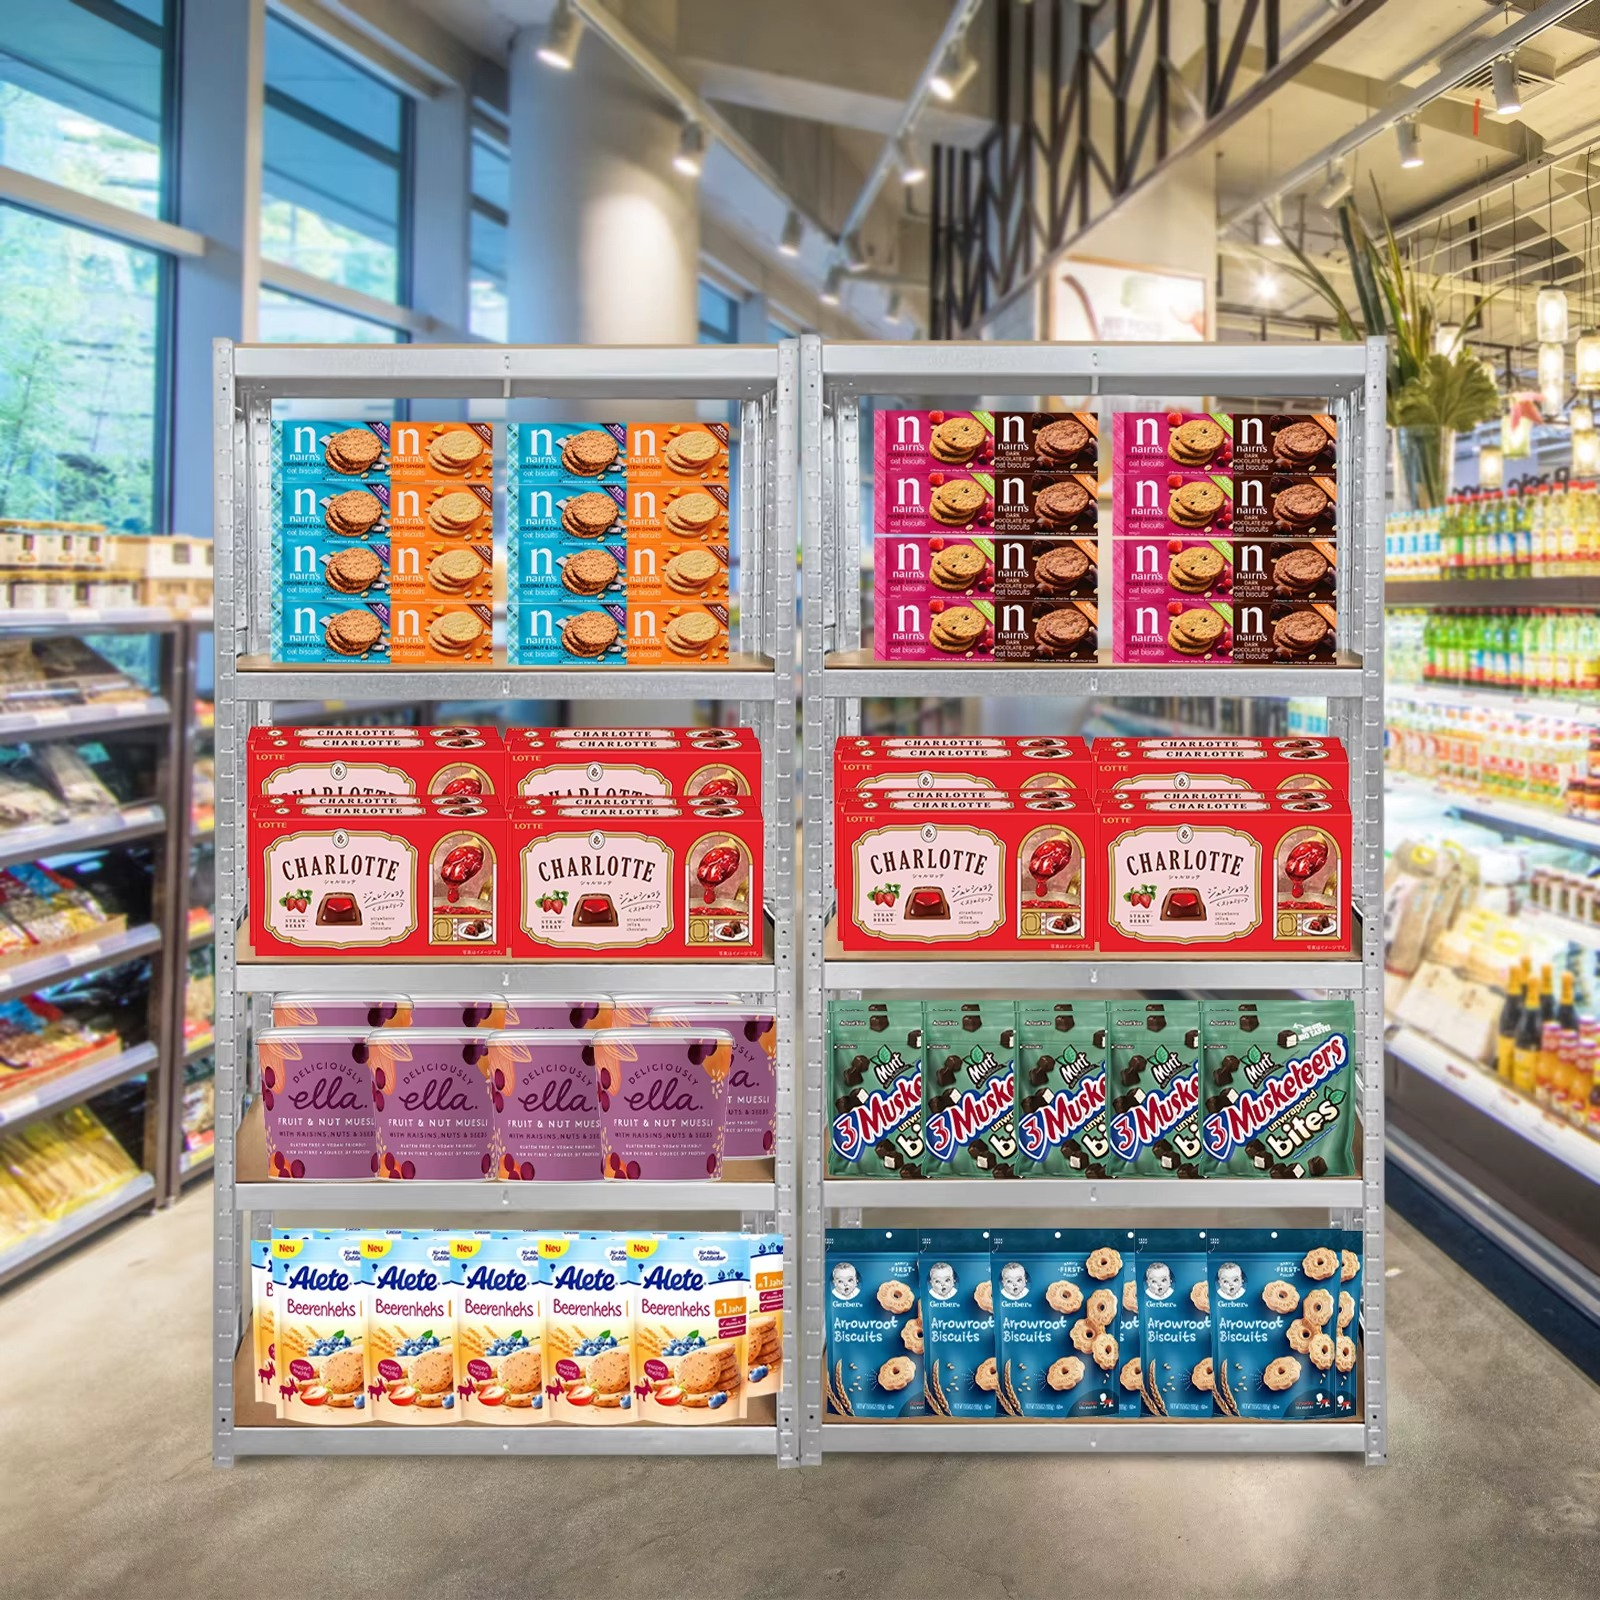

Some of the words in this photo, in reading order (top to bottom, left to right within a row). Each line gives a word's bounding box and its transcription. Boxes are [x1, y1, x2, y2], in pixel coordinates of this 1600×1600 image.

[898, 415, 920, 443] n
[1241, 418, 1263, 445] n
[294, 426, 316, 453] n
[634, 430, 656, 455] n
[893, 443, 925, 451] nairn's
[1131, 445, 1163, 453] nairn's
[1237, 445, 1267, 453] nairn's
[290, 453, 320, 461] nairn's
[629, 456, 660, 464] nairn's
[998, 504, 1029, 512] nairn's
[1131, 507, 1163, 515] nairn's
[290, 515, 320, 523] nairn's
[393, 517, 424, 525] nairn's
[526, 517, 556, 525] nairn's
[290, 634, 320, 642] nairn's
[393, 636, 424, 644] nairn's
[526, 636, 556, 644] nairn's
[629, 636, 660, 644] nairn's
[998, 631, 1029, 639] nairn's
[282, 855, 400, 881] CHARLOTTE
[870, 848, 988, 875] CHARLOTTE
[1127, 849, 1244, 876] CHARLOTTE
[538, 856, 656, 883] CHARLOTTE
[292, 1062, 363, 1085] DELICIOUSLY
[403, 1063, 473, 1085] DELICIOUSLY
[629, 1063, 698, 1085] DELICIOUSLY
[876, 1053, 903, 1081] Mint
[969, 1053, 996, 1081] Mint
[1062, 1053, 1089, 1081] Mint
[1153, 1053, 1181, 1082] Mint
[1246, 1053, 1273, 1082] Mint
[522, 1064, 592, 1086] DELICIOUSLY
[734, 1096, 770, 1104] MUESLI
[1207, 1118, 1226, 1150] 3
[1228, 1038, 1344, 1141] Musketeers
[838, 1117, 856, 1150] 3
[859, 1070, 921, 1140] Muske
[930, 1117, 949, 1150] 3
[952, 1070, 1014, 1140] Muske
[1023, 1117, 1042, 1150] 3
[1045, 1070, 1105, 1140] Muske
[1114, 1118, 1133, 1150] 3
[1135, 1074, 1198, 1141] Muske
[1268, 1090, 1318, 1131] unwrapped
[278, 1118, 302, 1126] FRUIT
[307, 1118, 313, 1126] &
[319, 1118, 340, 1126] NUT
[345, 1118, 375, 1126] MUESL
[389, 1119, 413, 1127] FRUIT
[418, 1119, 424, 1127] &
[429, 1119, 450, 1127] NUT
[456, 1119, 487, 1127] MUESLI
[508, 1120, 532, 1128] FRUIT
[537, 1120, 543, 1128] &
[548, 1120, 570, 1128] NUT
[575, 1120, 601, 1128] MUES
[614, 1119, 638, 1127] FRUIT
[643, 1119, 649, 1127] &
[654, 1119, 675, 1127] NUT
[681, 1119, 713, 1127] MUESLI
[1268, 1101, 1339, 1158] bites
[279, 1244, 295, 1253] Neu
[368, 1244, 383, 1253] Neu
[457, 1244, 472, 1253] Neu
[545, 1244, 561, 1253] Neu
[634, 1244, 649, 1253] Neu
[289, 1266, 349, 1291] Alete
[377, 1266, 437, 1291] Alete
[467, 1266, 526, 1291] Alete
[555, 1266, 615, 1291] Alete
[643, 1266, 703, 1291] Alete
[287, 1299, 355, 1317] Beerenkeks
[376, 1299, 444, 1317] Beerenkeks
[465, 1299, 533, 1317] Beerenkeks
[553, 1299, 621, 1317] Beerenkeks
[642, 1299, 710, 1317] Beerenkeks
[729, 1304, 743, 1314] Jahr
[834, 1316, 898, 1330] Arrowroot
[931, 1316, 994, 1330] Arrowroot
[1003, 1316, 1067, 1330] Arrowroot
[1148, 1316, 1211, 1330] Arrowroot
[1220, 1316, 1283, 1330] Arrowroot
[834, 1331, 882, 1342] Biscuits
[932, 1331, 979, 1342] Biscuits
[1003, 1331, 1051, 1342] Biscuits
[1148, 1331, 1196, 1342] Biscuits
[1220, 1331, 1268, 1342] Biscuits
